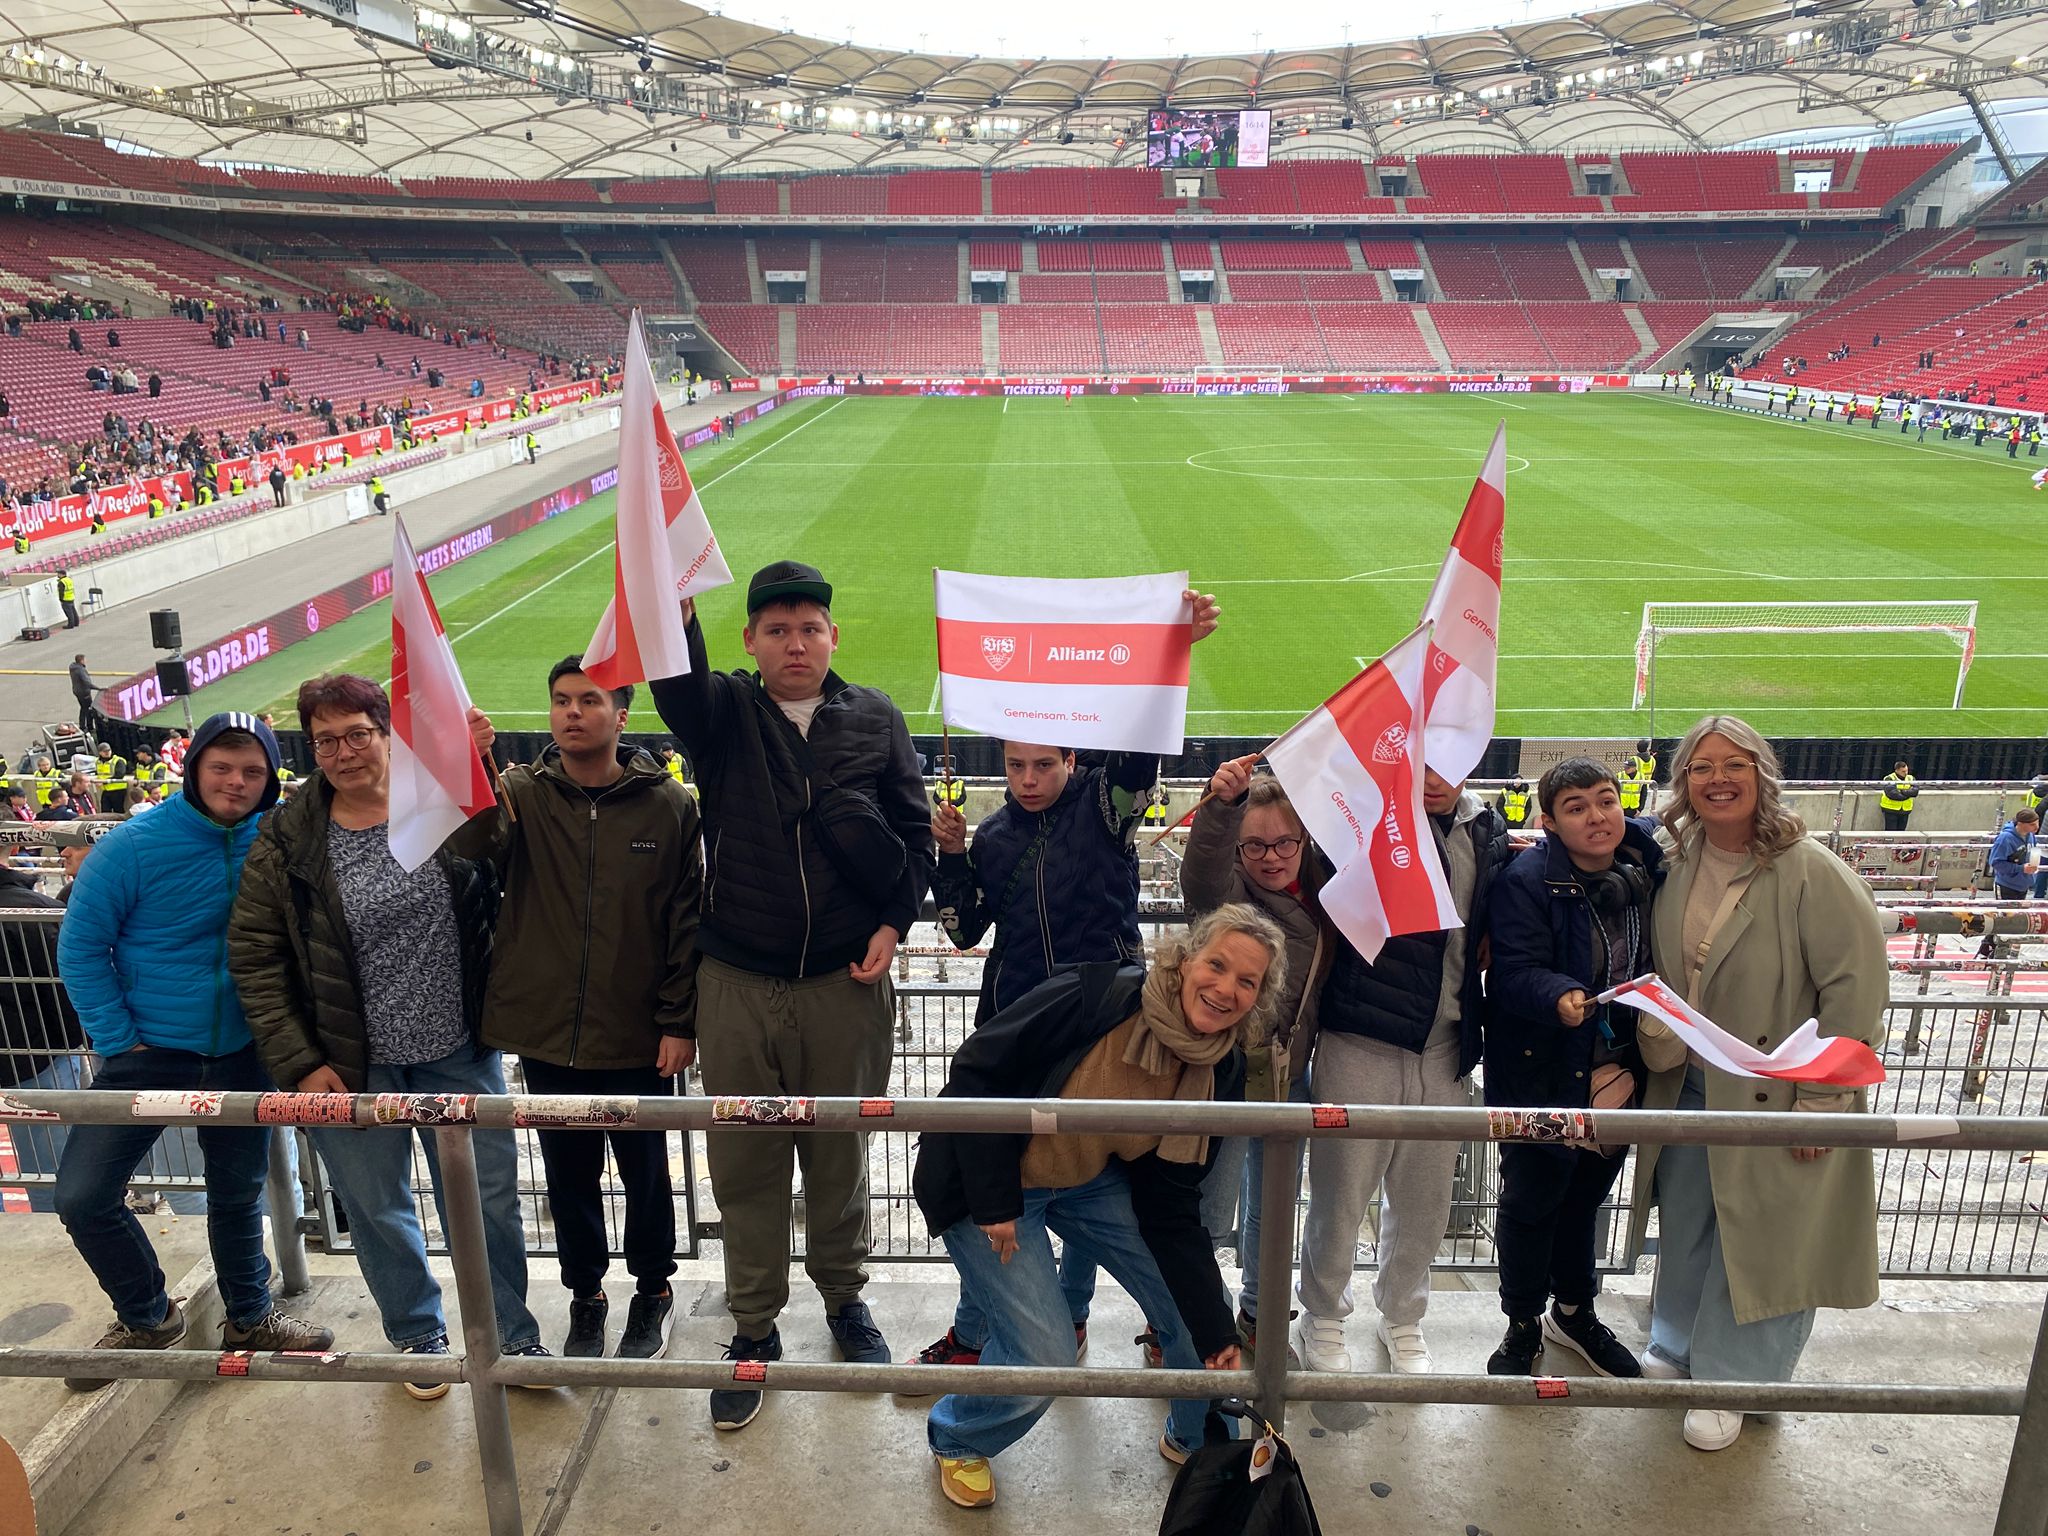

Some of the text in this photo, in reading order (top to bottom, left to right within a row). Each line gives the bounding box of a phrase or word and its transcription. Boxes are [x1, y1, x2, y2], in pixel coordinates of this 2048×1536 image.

[1449, 382, 1532, 392] TICKETS.DFB.DE
[450, 524, 493, 562] SICHERN!
[1047, 646, 1105, 662] Allianz
[1004, 708, 1102, 723] Gemeinsam. Stark.
[1540, 751, 1565, 762] EXIT
[1605, 751, 1630, 762] EXIT
